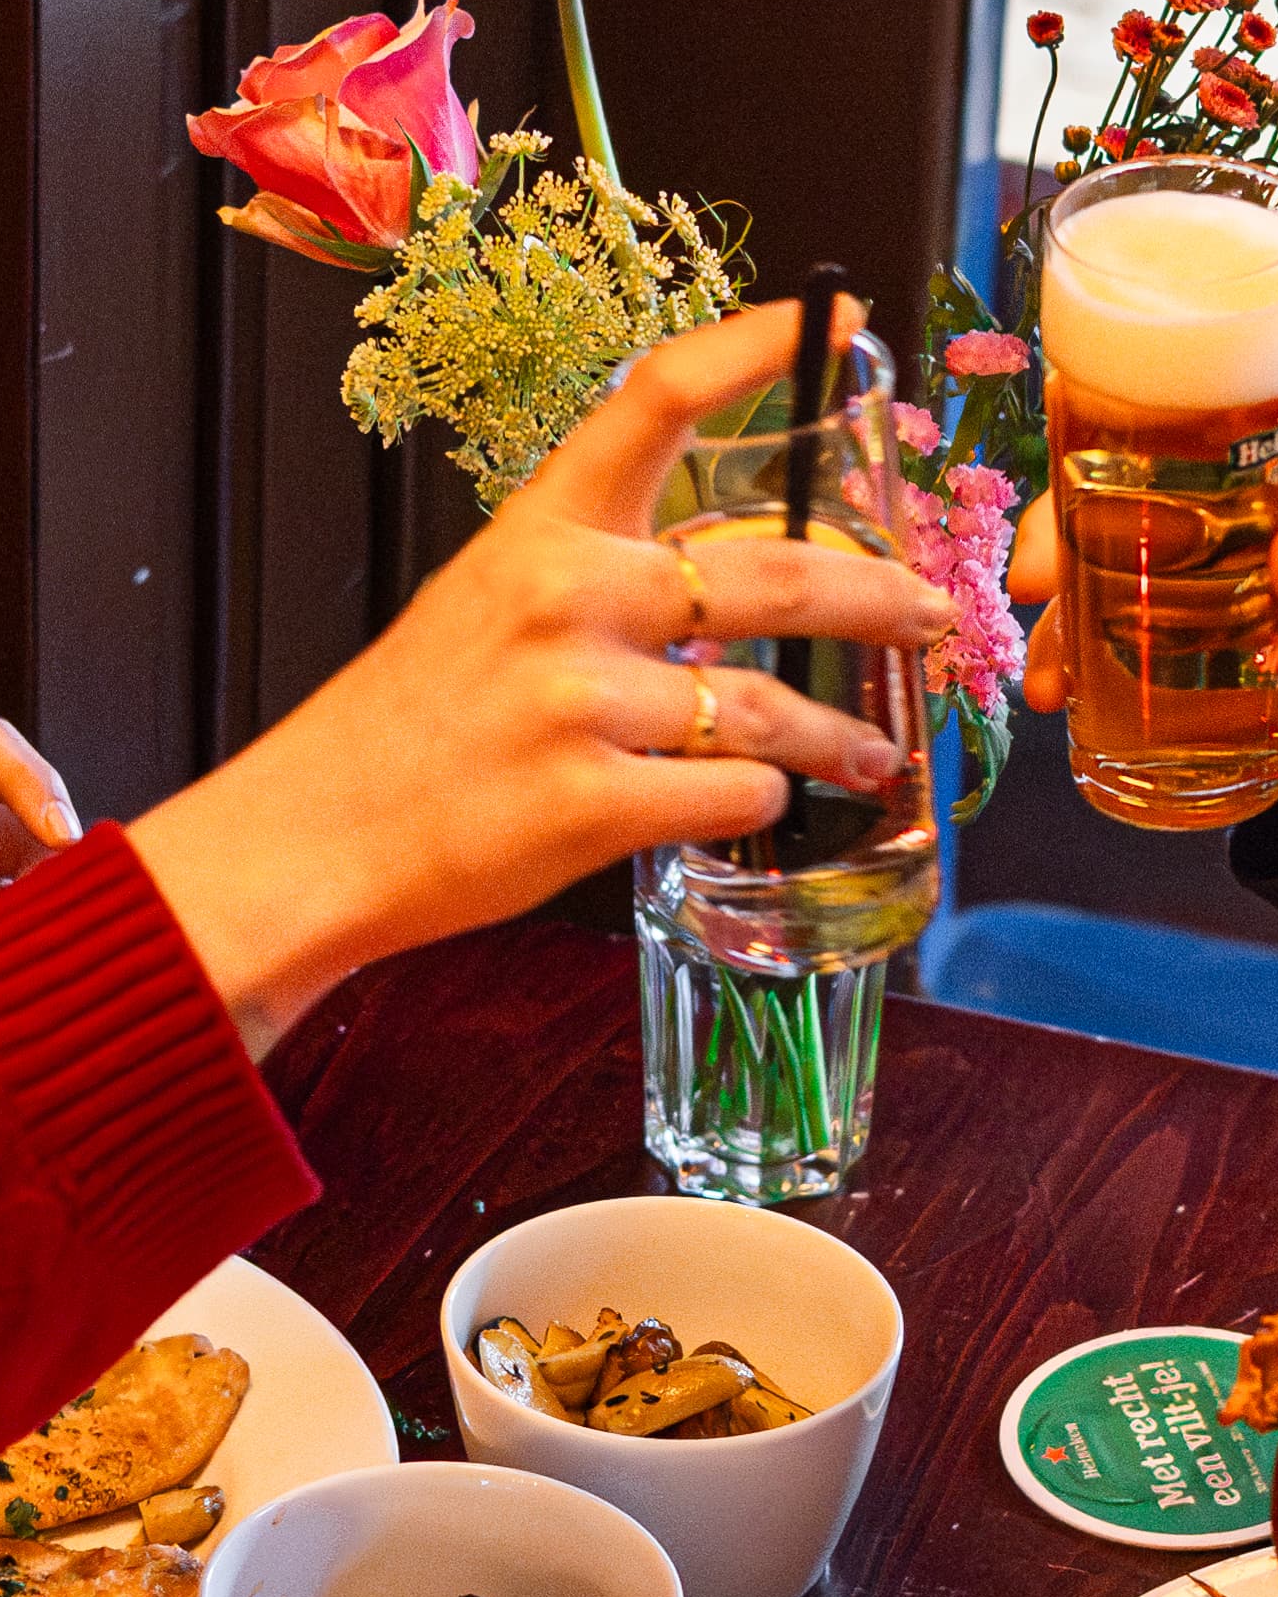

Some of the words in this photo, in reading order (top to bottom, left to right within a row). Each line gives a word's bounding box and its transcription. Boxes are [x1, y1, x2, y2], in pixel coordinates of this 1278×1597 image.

[1102, 1372, 1167, 1451] recht
[1139, 1359, 1213, 1451] vilt-je!
[1141, 1452, 1196, 1510] Met
[1195, 1452, 1241, 1507] een
